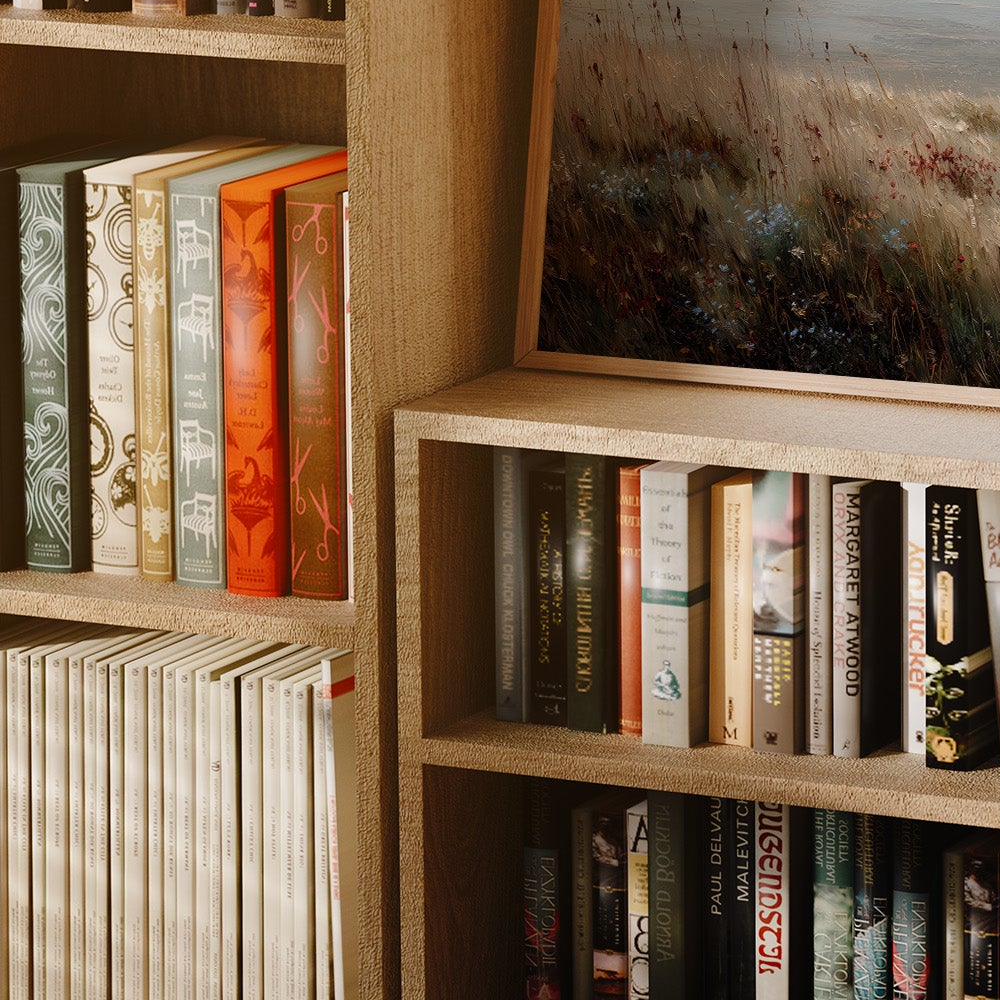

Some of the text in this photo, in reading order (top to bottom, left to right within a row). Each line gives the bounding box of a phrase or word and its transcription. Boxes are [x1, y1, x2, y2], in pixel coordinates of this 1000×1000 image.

[662, 504, 671, 513] of
[658, 521, 673, 531] the
[652, 537, 681, 549] Theory
[662, 555, 671, 564] of
[501, 455, 515, 690] DOWNTOWN OWL CHUCK KLOSTERMAN
[650, 571, 682, 582] Fiction
[833, 493, 845, 669] ORYX AND CRAKE
[813, 591, 822, 624] House
[845, 493, 860, 697] MARGARET ATWOOD
[811, 628, 822, 638] of
[811, 642, 822, 688] Splendid
[812, 693, 822, 739] Isolation
[710, 797, 722, 915] PAUL DELVAU
